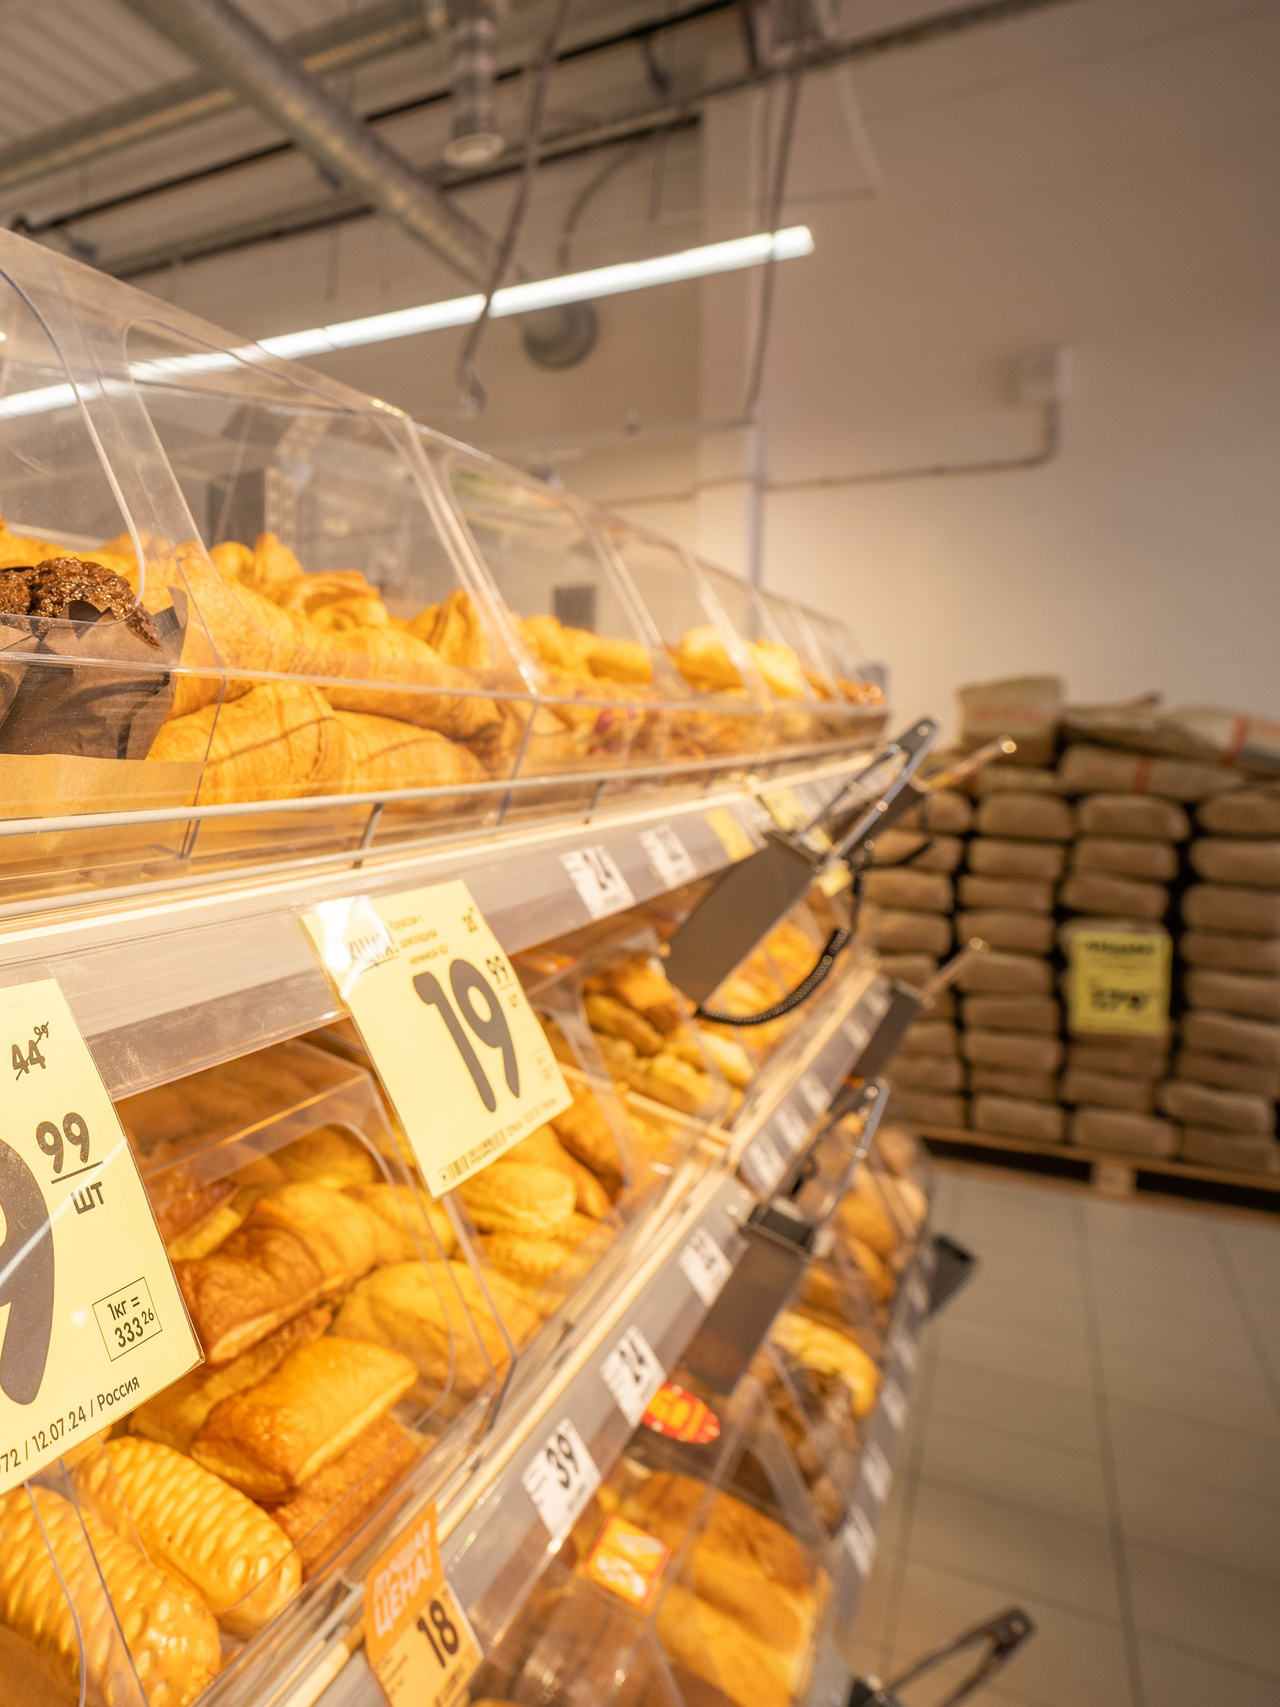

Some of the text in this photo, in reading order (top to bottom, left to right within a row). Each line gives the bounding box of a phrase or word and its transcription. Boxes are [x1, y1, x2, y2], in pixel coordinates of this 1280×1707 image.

[11, 1039, 47, 1075] 44
[412, 958, 520, 1113] 19
[35, 1111, 91, 1175] 99
[107, 1296, 141, 1321] 1кг =
[114, 1316, 144, 1349] 333
[31, 1405, 87, 1453] 12.07.24
[96, 1376, 141, 1412] Россия
[546, 1433, 580, 1489] 39
[374, 1546, 434, 1639] ЦЕНА!
[416, 1600, 460, 1669] 18
